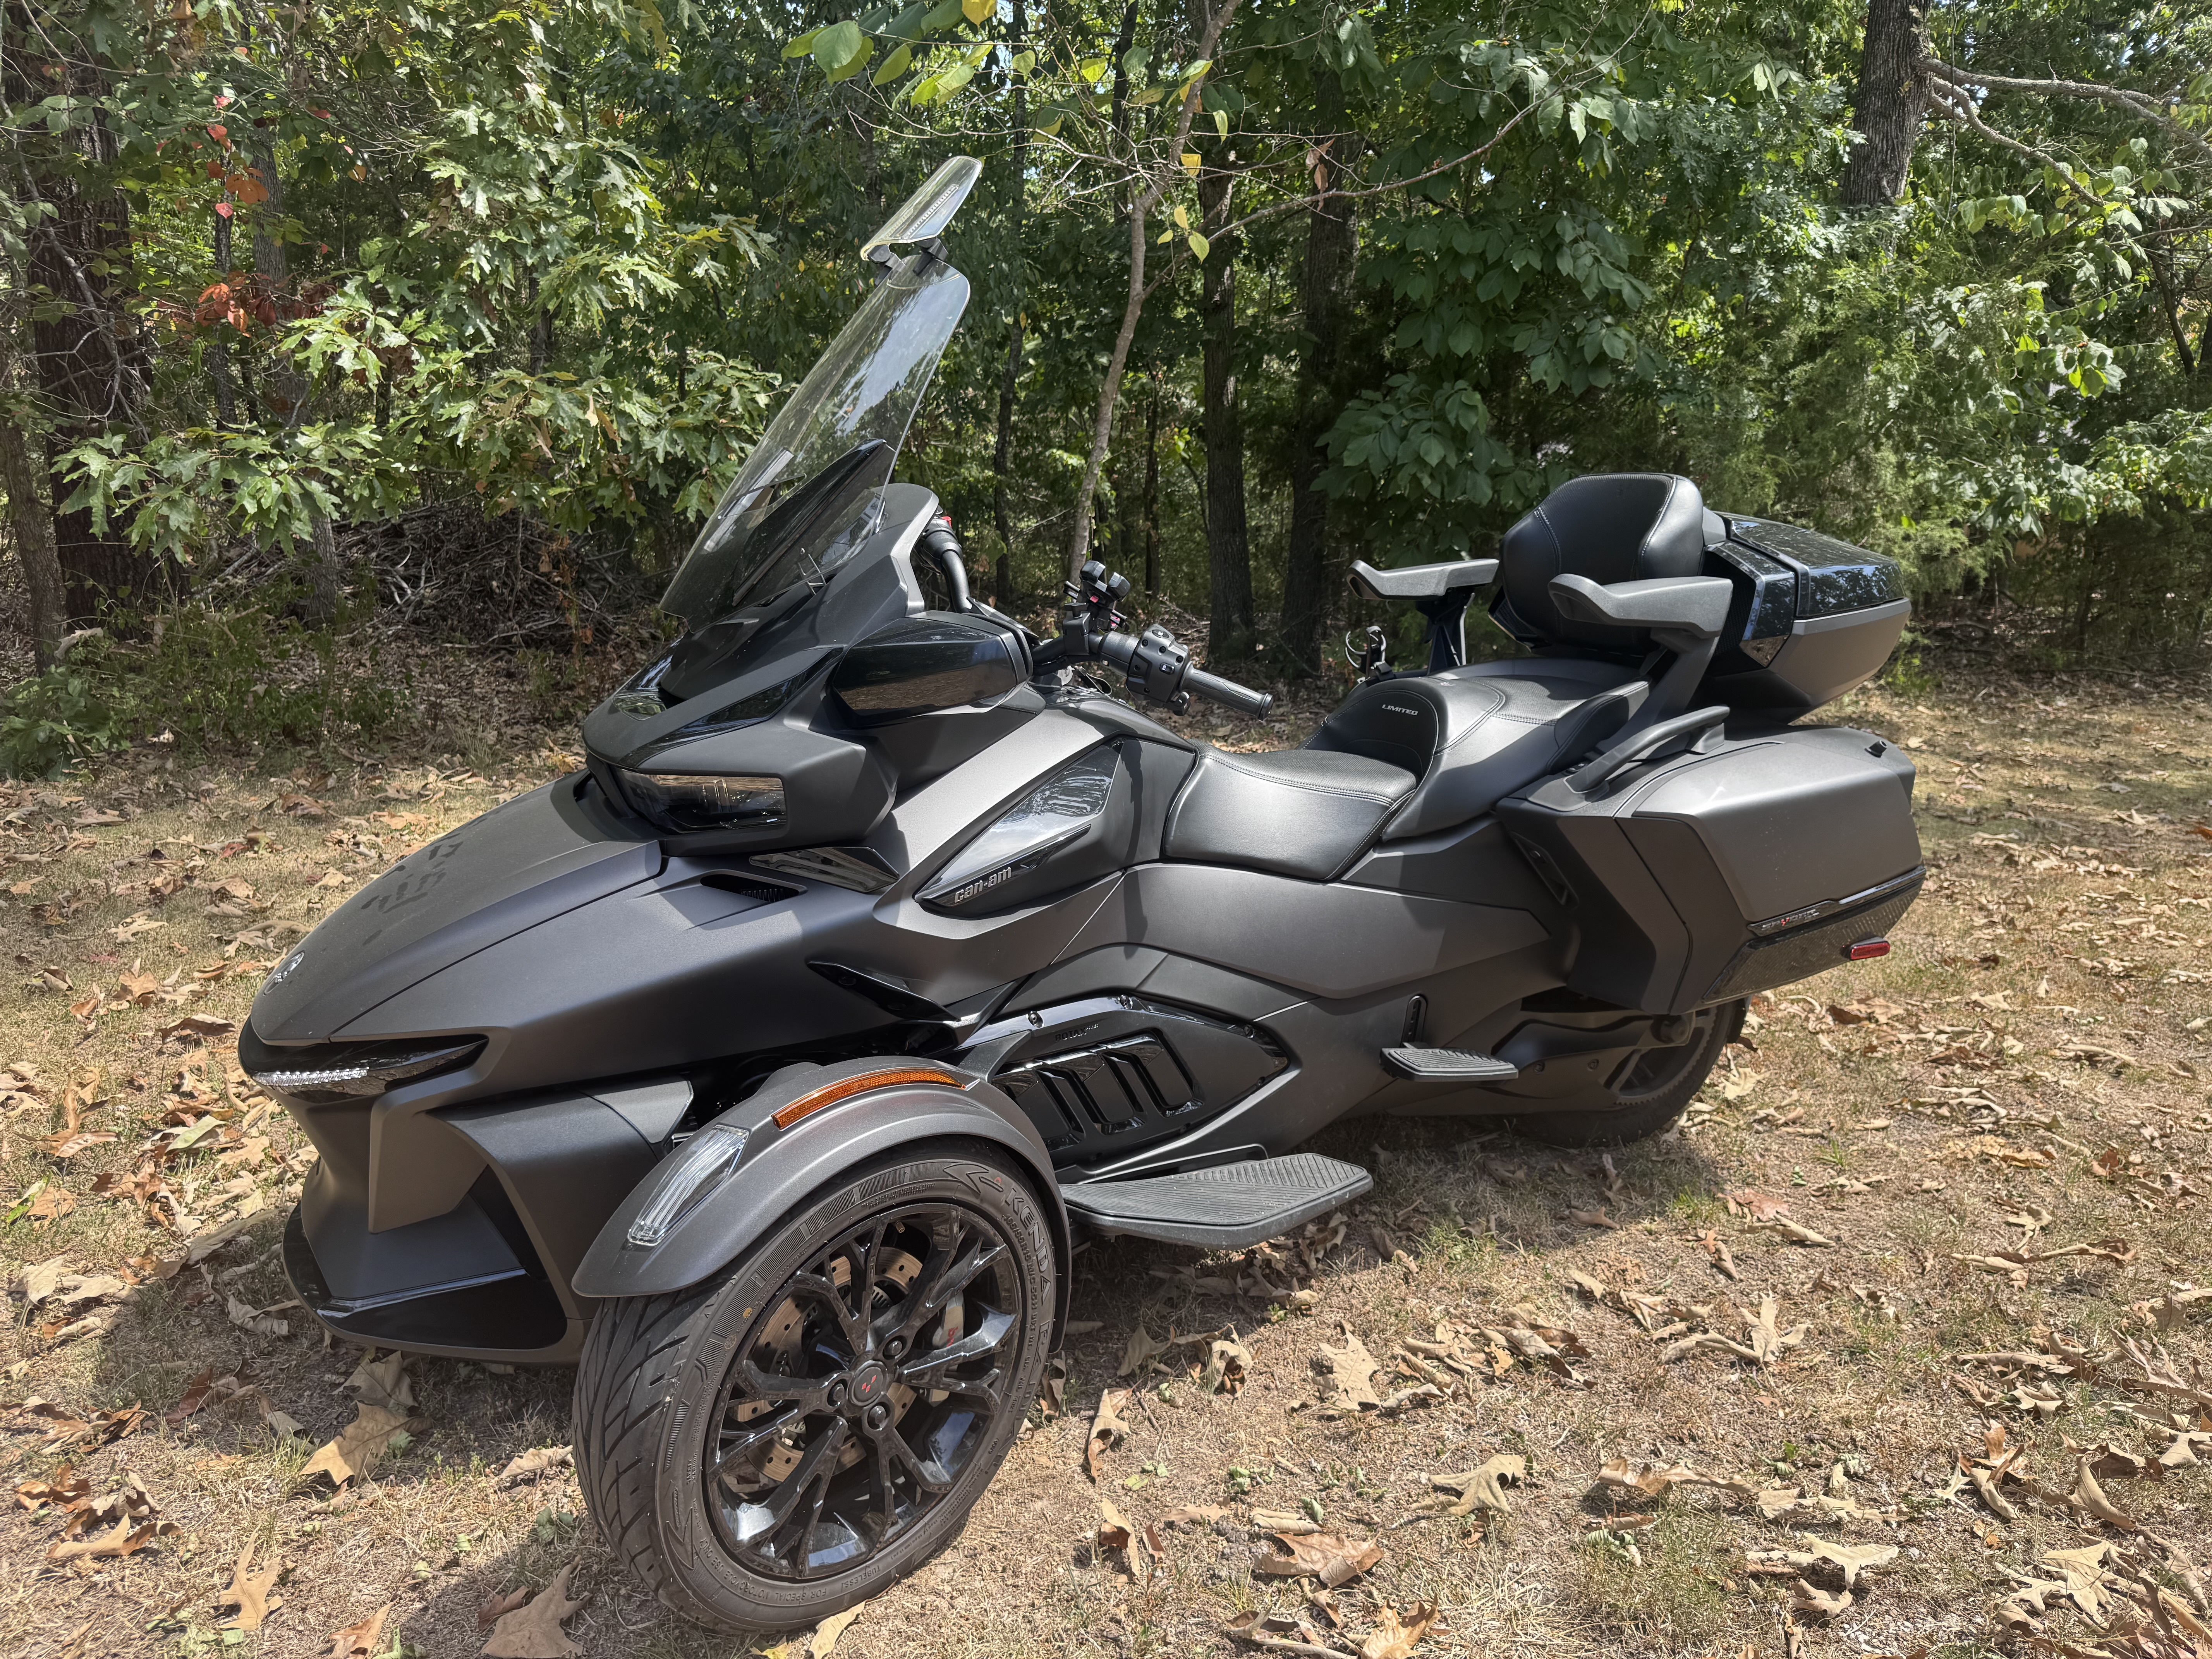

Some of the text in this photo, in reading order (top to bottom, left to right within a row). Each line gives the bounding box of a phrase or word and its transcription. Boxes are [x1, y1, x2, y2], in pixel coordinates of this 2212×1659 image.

[1382, 704, 1418, 715] LIMITED
[955, 866, 1012, 903] can-am
[1055, 1028, 1087, 1041] ROTAX
[1005, 1187, 1051, 1307] KENDA
[699, 1537, 826, 1601] FOR SPECIAL MOTORCYCLE USE ONLY
[845, 1565, 880, 1588] TUBELESS
